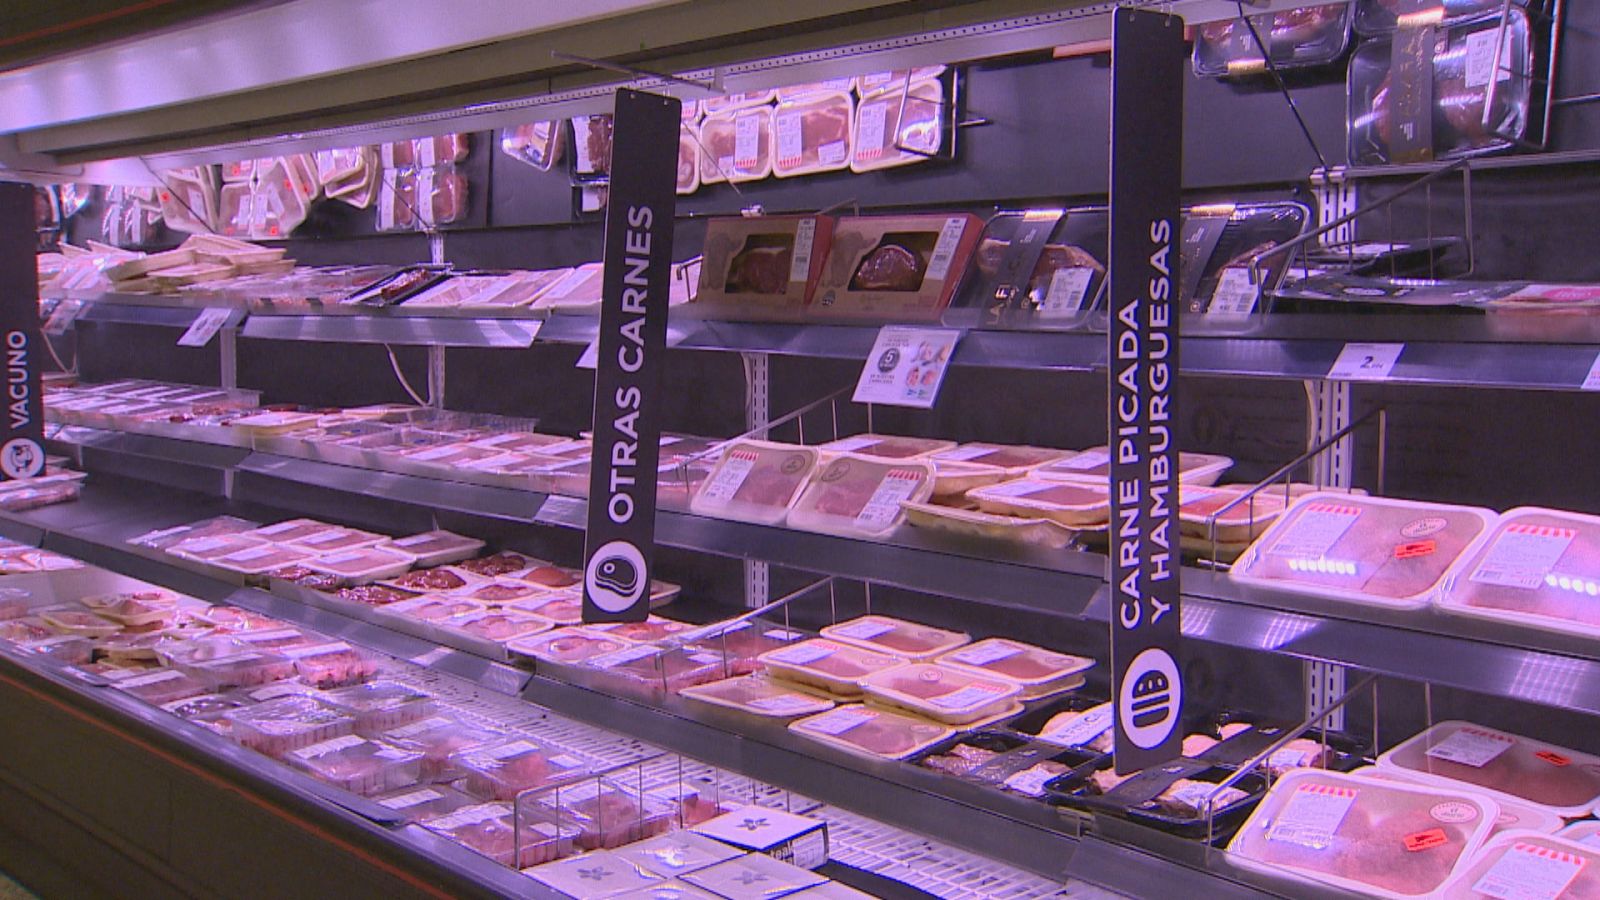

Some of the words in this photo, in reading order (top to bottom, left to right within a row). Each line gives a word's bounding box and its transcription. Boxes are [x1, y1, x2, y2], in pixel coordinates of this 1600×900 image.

[618, 205, 653, 372] CARNES
[6, 331, 30, 429] VACUNO
[608, 386, 642, 524] OTRAS
[1118, 299, 1139, 465] PICADA
[1149, 219, 1171, 581] HAMBURGUESAS
[1119, 478, 1141, 630] CARNE
[1151, 596, 1171, 624] Y
